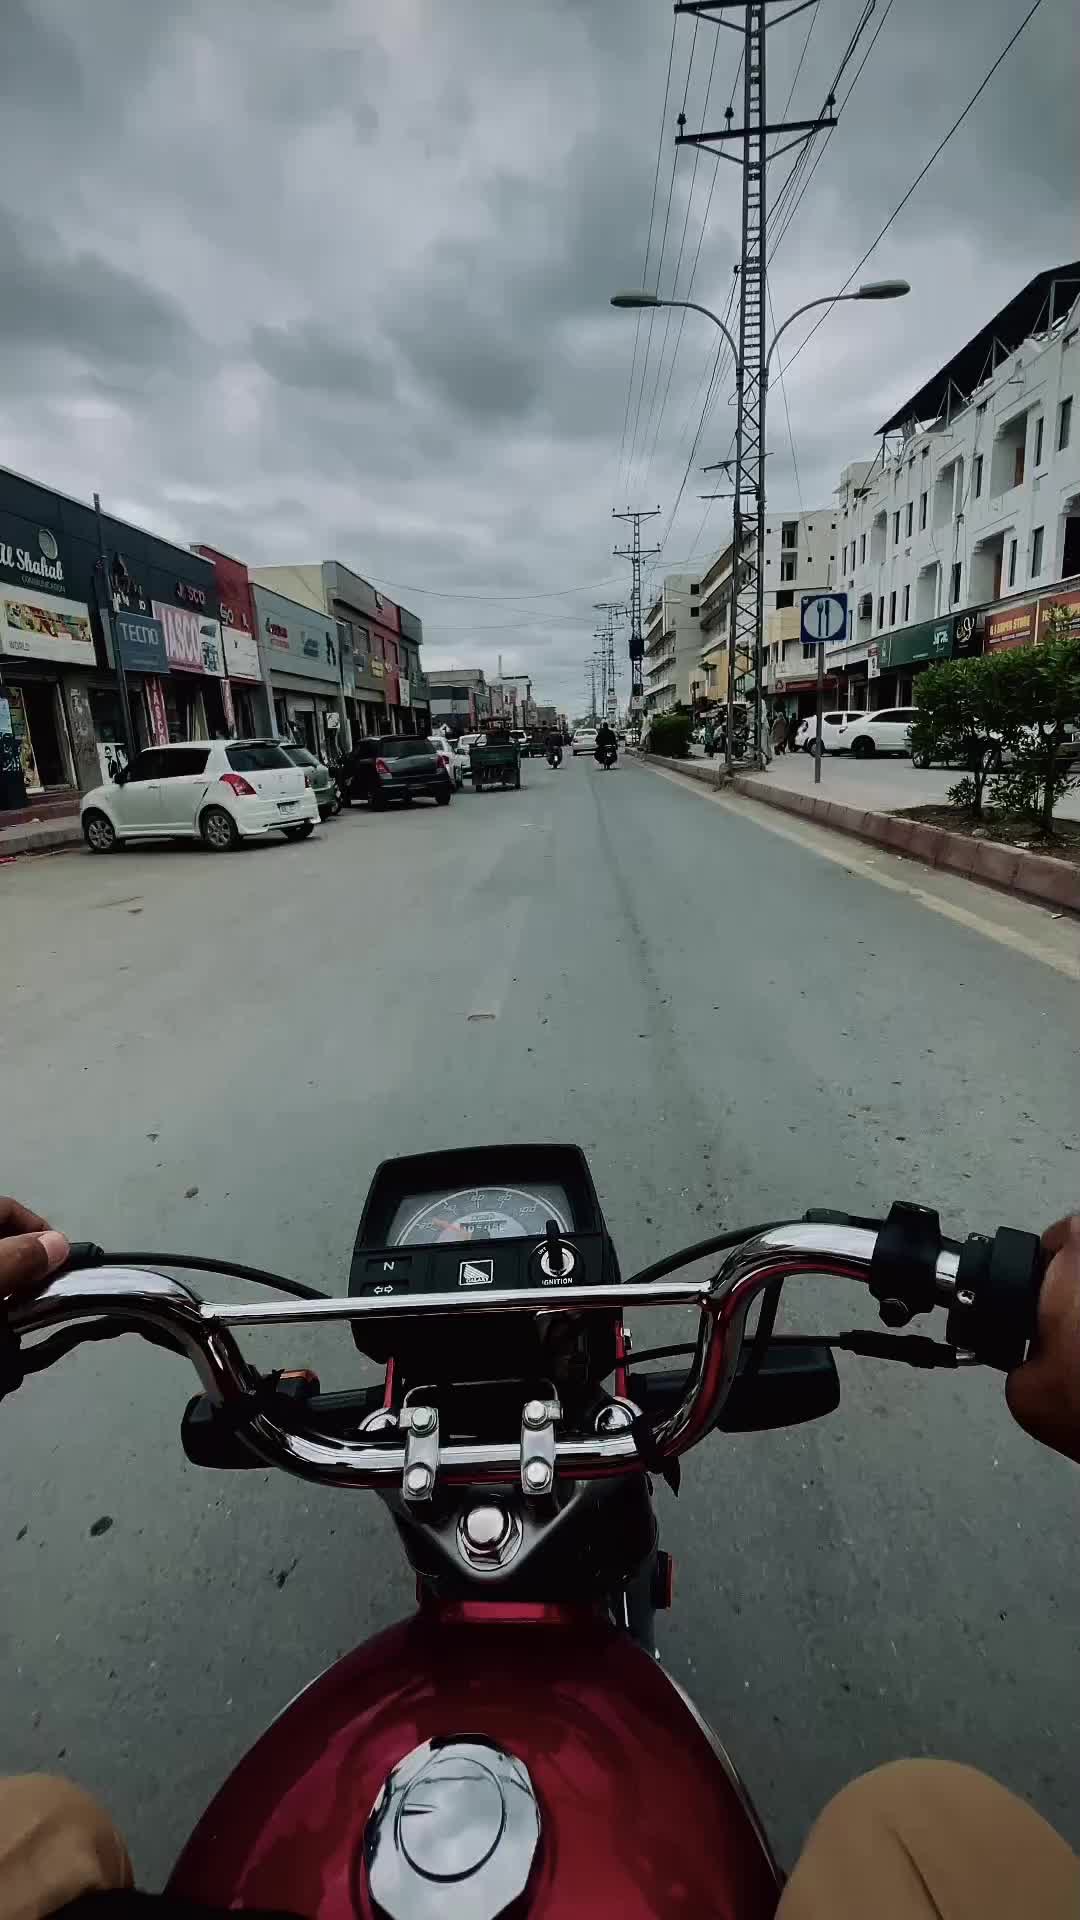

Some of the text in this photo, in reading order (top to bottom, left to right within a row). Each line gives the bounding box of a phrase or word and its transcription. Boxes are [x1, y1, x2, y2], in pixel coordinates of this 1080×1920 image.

[16, 548, 64, 580] Shahab
[177, 581, 206, 605] JSCO
[120, 623, 158, 645] TECNO
[383, 1261, 395, 1271] N
[541, 1277, 573, 1286] IGNITION
